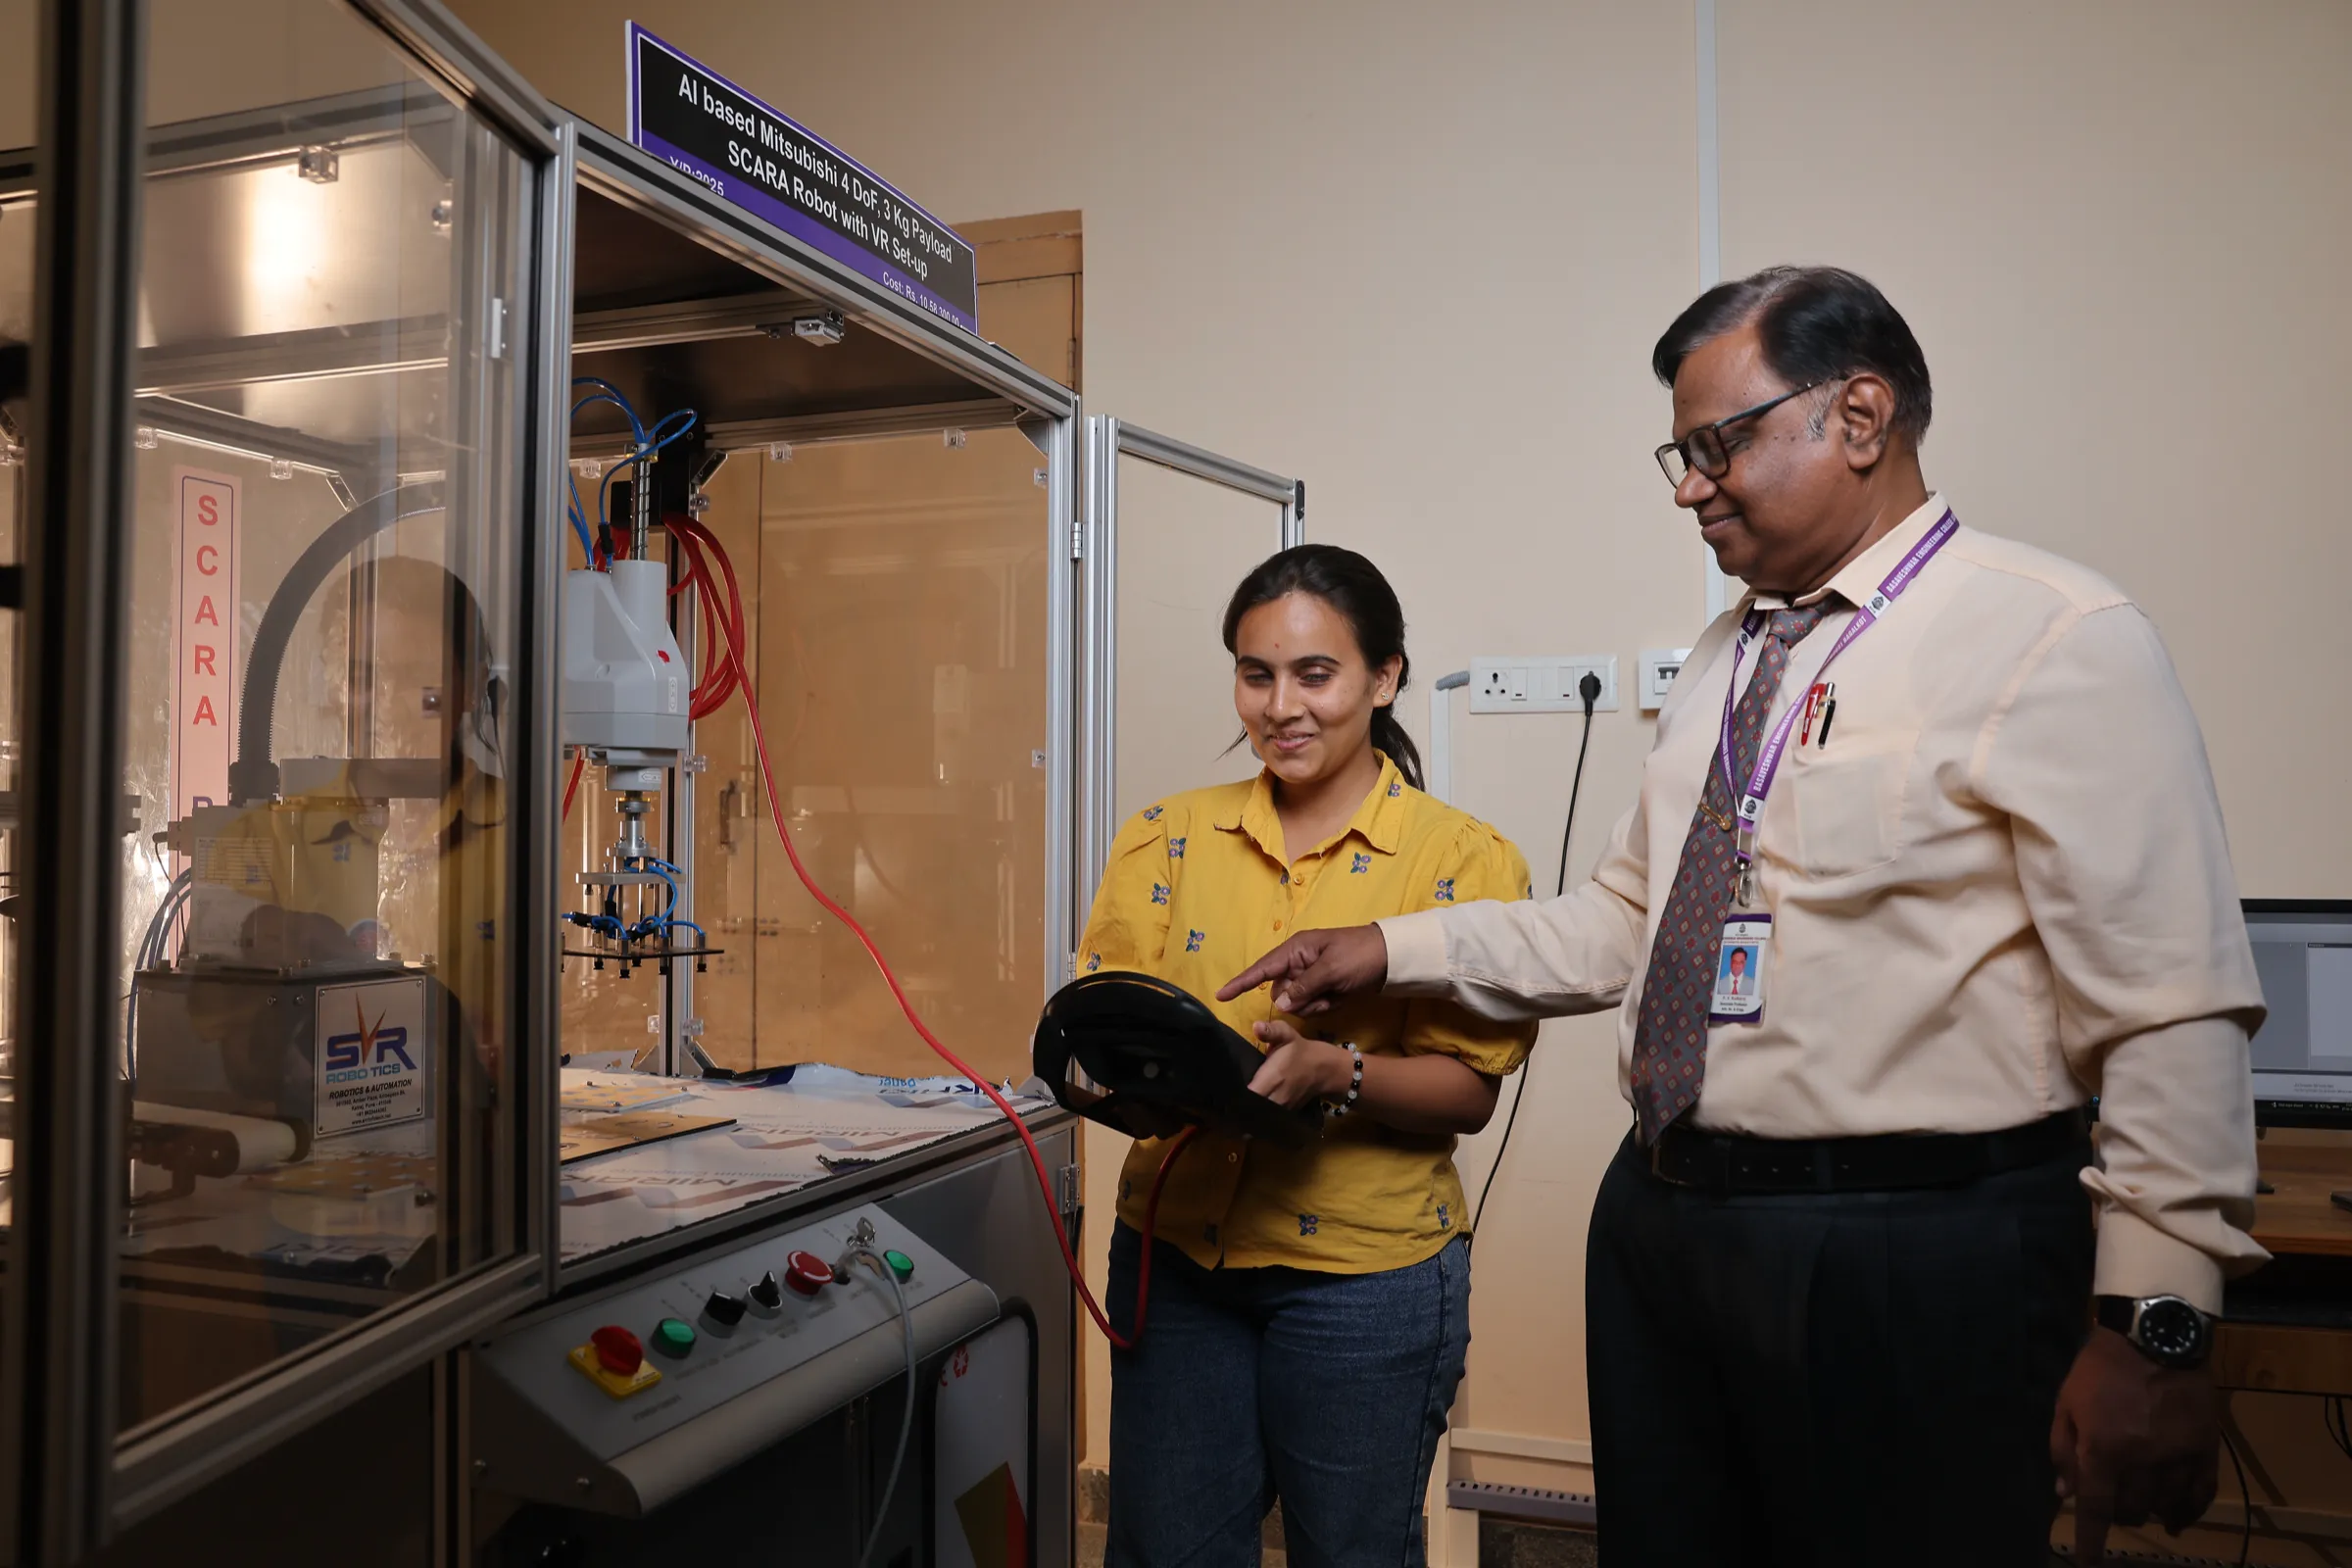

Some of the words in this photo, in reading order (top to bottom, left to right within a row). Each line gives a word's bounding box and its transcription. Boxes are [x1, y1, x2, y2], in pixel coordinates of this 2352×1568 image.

[678, 74, 698, 106] AI
[703, 85, 756, 138] based
[760, 119, 838, 187] Mitsubishi
[841, 172, 850, 195] 4
[853, 177, 880, 219] DoF,
[884, 199, 891, 221] 3
[894, 205, 909, 239] Kg
[912, 218, 953, 265] Payload
[728, 140, 791, 196] SCARA
[793, 175, 838, 223] Robot
[841, 209, 868, 241] with
[871, 222, 889, 254] VR
[892, 237, 928, 281] Set-up
[883, 271, 905, 295] Cost:
[906, 284, 918, 304] Rs.
[1915, 529, 1944, 560] ENGINEERING
[1753, 745, 1777, 793] BASAVESHWAR
[1773, 706, 1797, 745] ENGINEERING
[325, 991, 417, 1072] SVR
[328, 1087, 364, 1100] ROBOTICS
[366, 1085, 370, 1094] &
[370, 1079, 413, 1094] AUTOMATION
